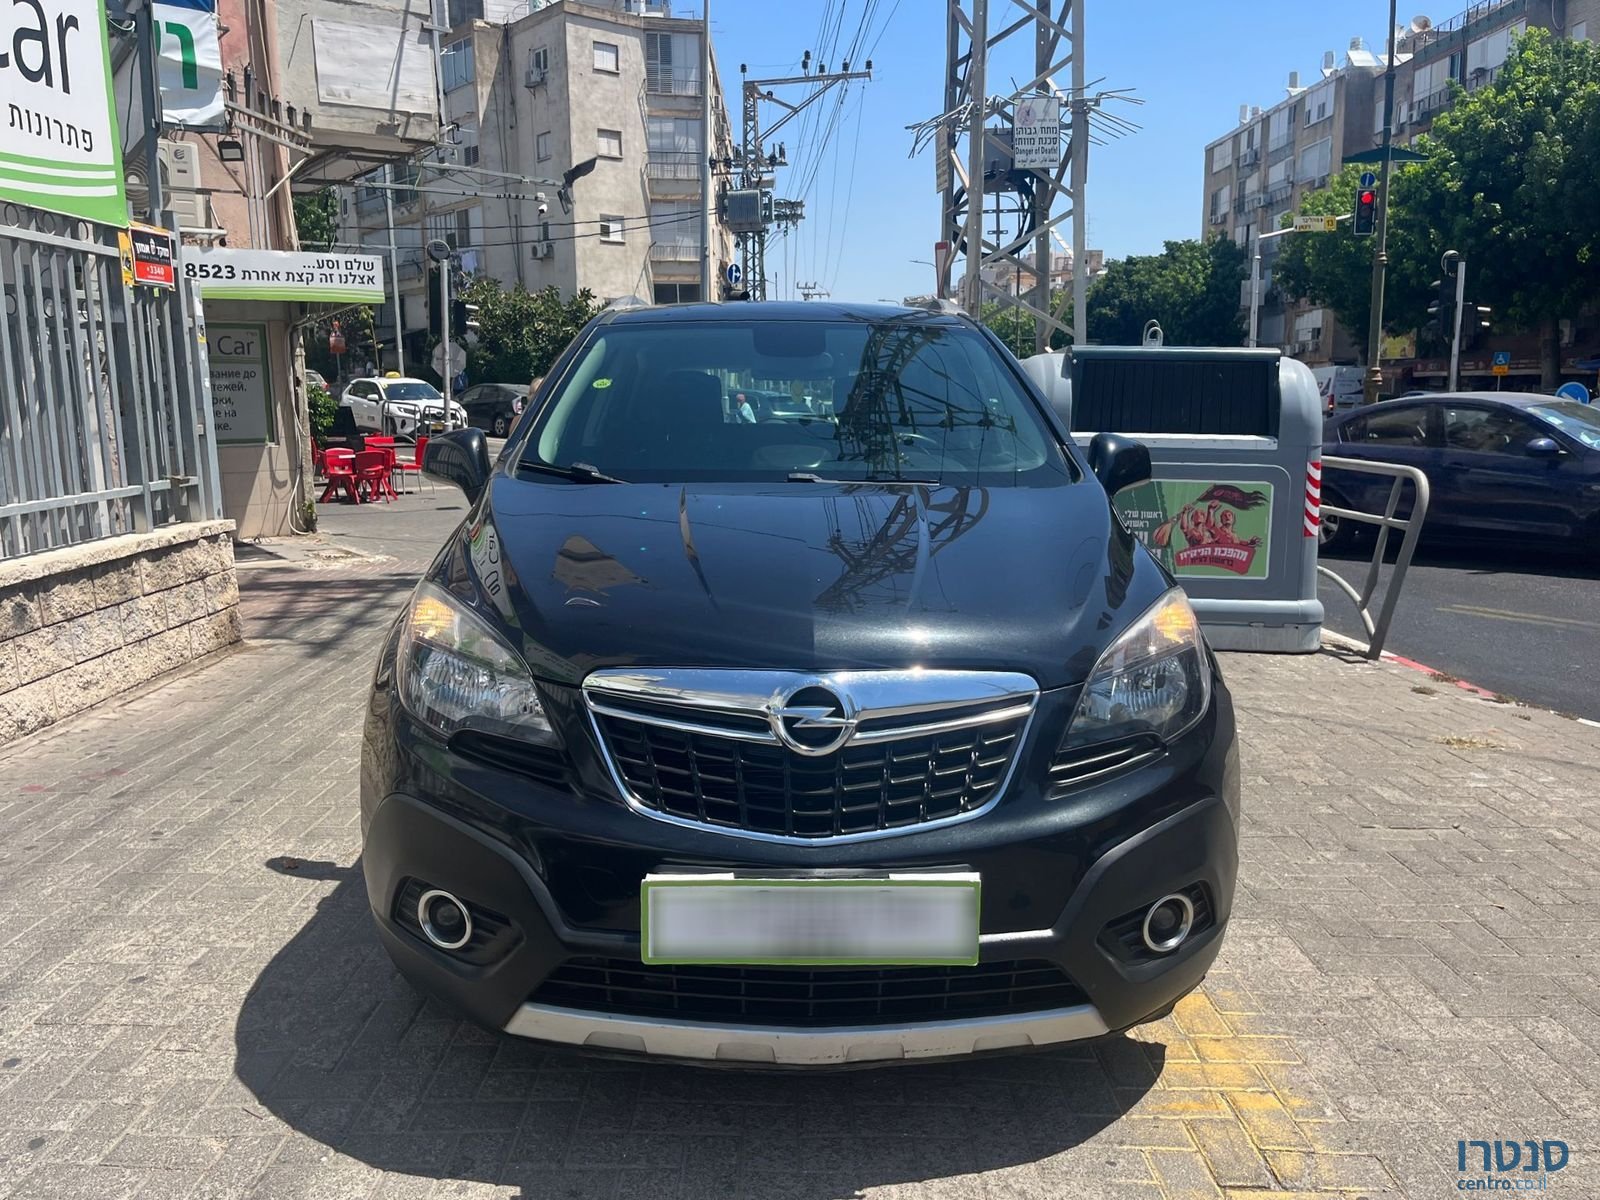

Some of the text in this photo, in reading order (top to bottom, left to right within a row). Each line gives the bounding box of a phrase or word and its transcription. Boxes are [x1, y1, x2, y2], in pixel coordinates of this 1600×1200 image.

[0, 0, 79, 94] ar
[8, 103, 94, 152] פתרונות
[1015, 126, 1058, 135] מתח גבוה!
[1015, 137, 1058, 146] סכנת מוות!
[1015, 147, 1034, 156] Danger
[1041, 147, 1058, 155] Death!
[1327, 219, 1334, 227] 13
[303, 258, 375, 271] שלם וסע...
[184, 262, 376, 286] אצלנו זה קצת אחרת 8523
[217, 335, 255, 356] Car
[243, 370, 256, 379] до
[1140, 510, 1163, 520] ראשון
[1179, 547, 1249, 561] מהפכת הניקיון
